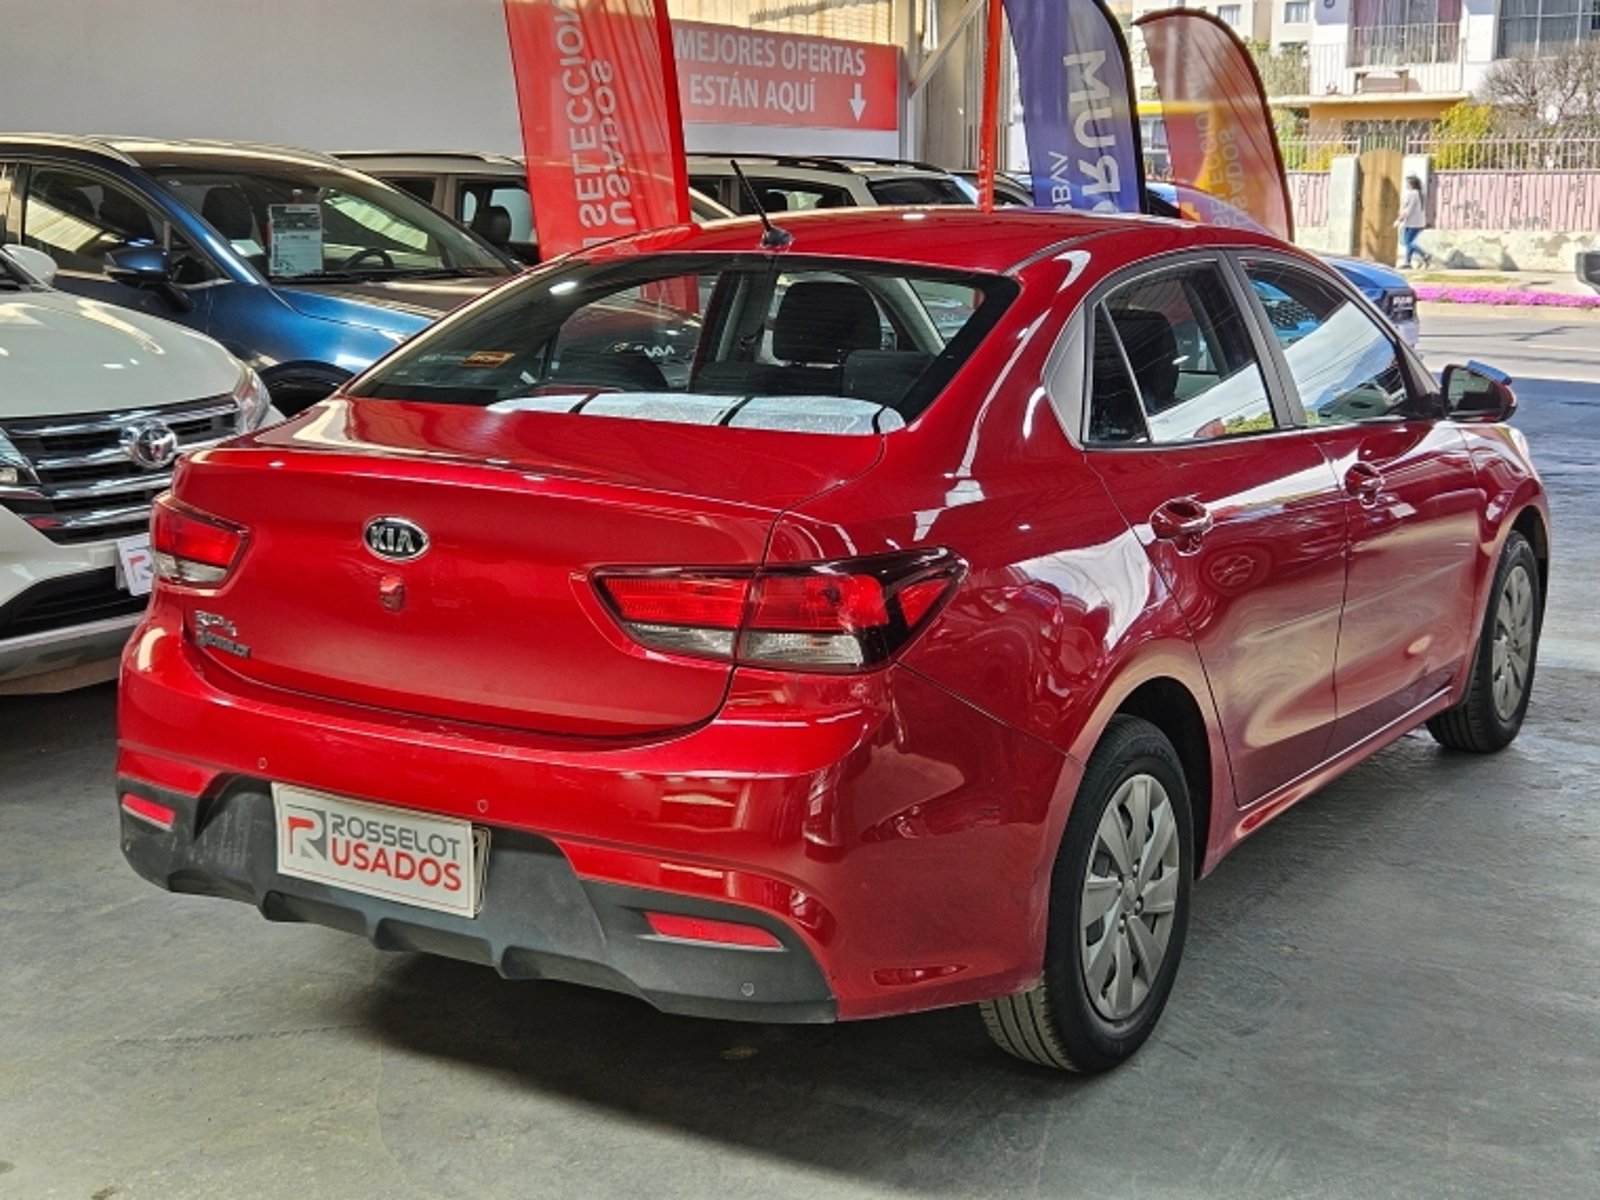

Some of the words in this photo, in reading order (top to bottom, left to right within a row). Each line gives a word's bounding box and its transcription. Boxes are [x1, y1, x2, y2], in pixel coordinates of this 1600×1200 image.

[674, 28, 776, 68] MEJORES
[781, 39, 866, 77] OFERTAS
[689, 71, 759, 108] ESTÁN
[764, 77, 816, 115] AQUÍ
[370, 525, 416, 553] KIA
[330, 813, 461, 860] ROSSELOT
[331, 837, 462, 892] USADOS
